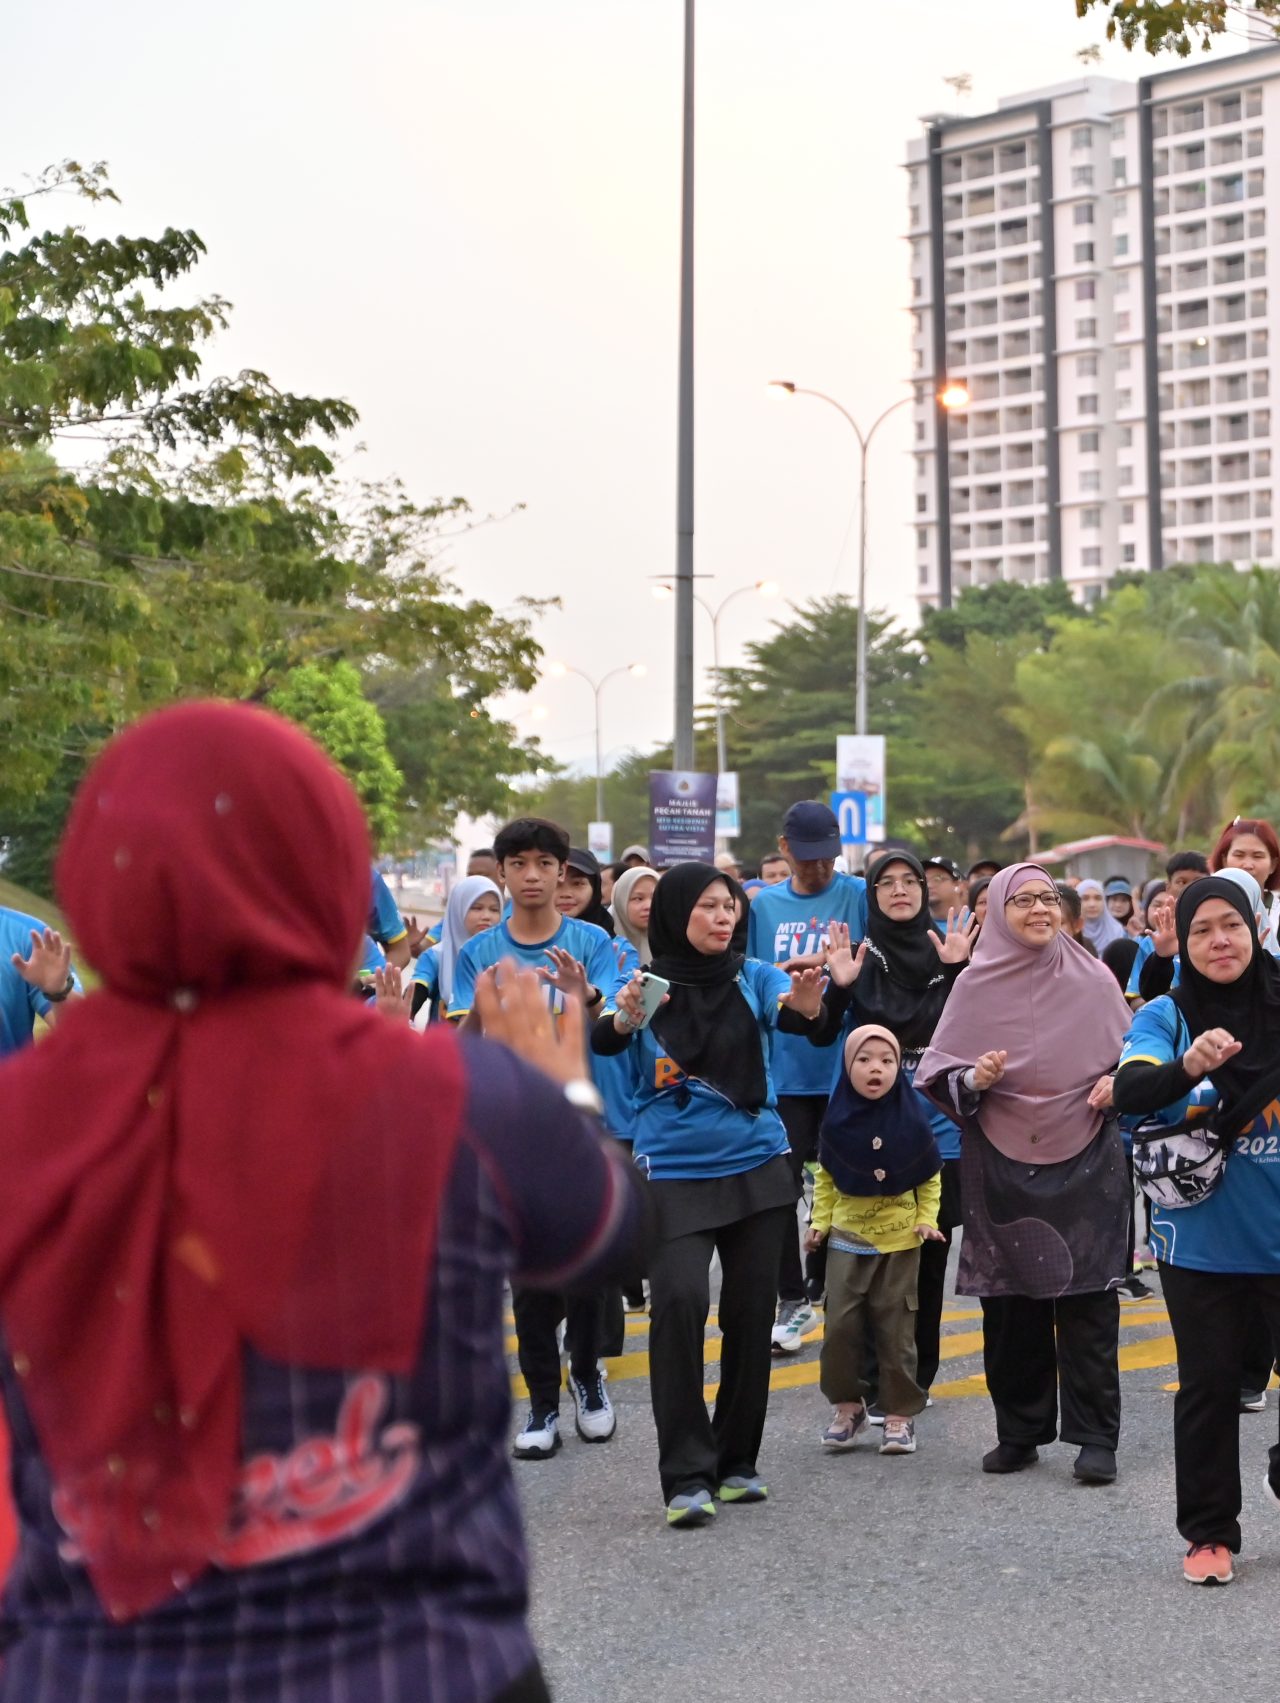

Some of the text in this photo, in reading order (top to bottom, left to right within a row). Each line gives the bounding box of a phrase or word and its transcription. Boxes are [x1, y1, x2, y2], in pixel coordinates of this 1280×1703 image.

[668, 799, 698, 808] MAJLIS
[654, 807, 711, 817] PECAH TANAH
[776, 921, 807, 934] MTD
